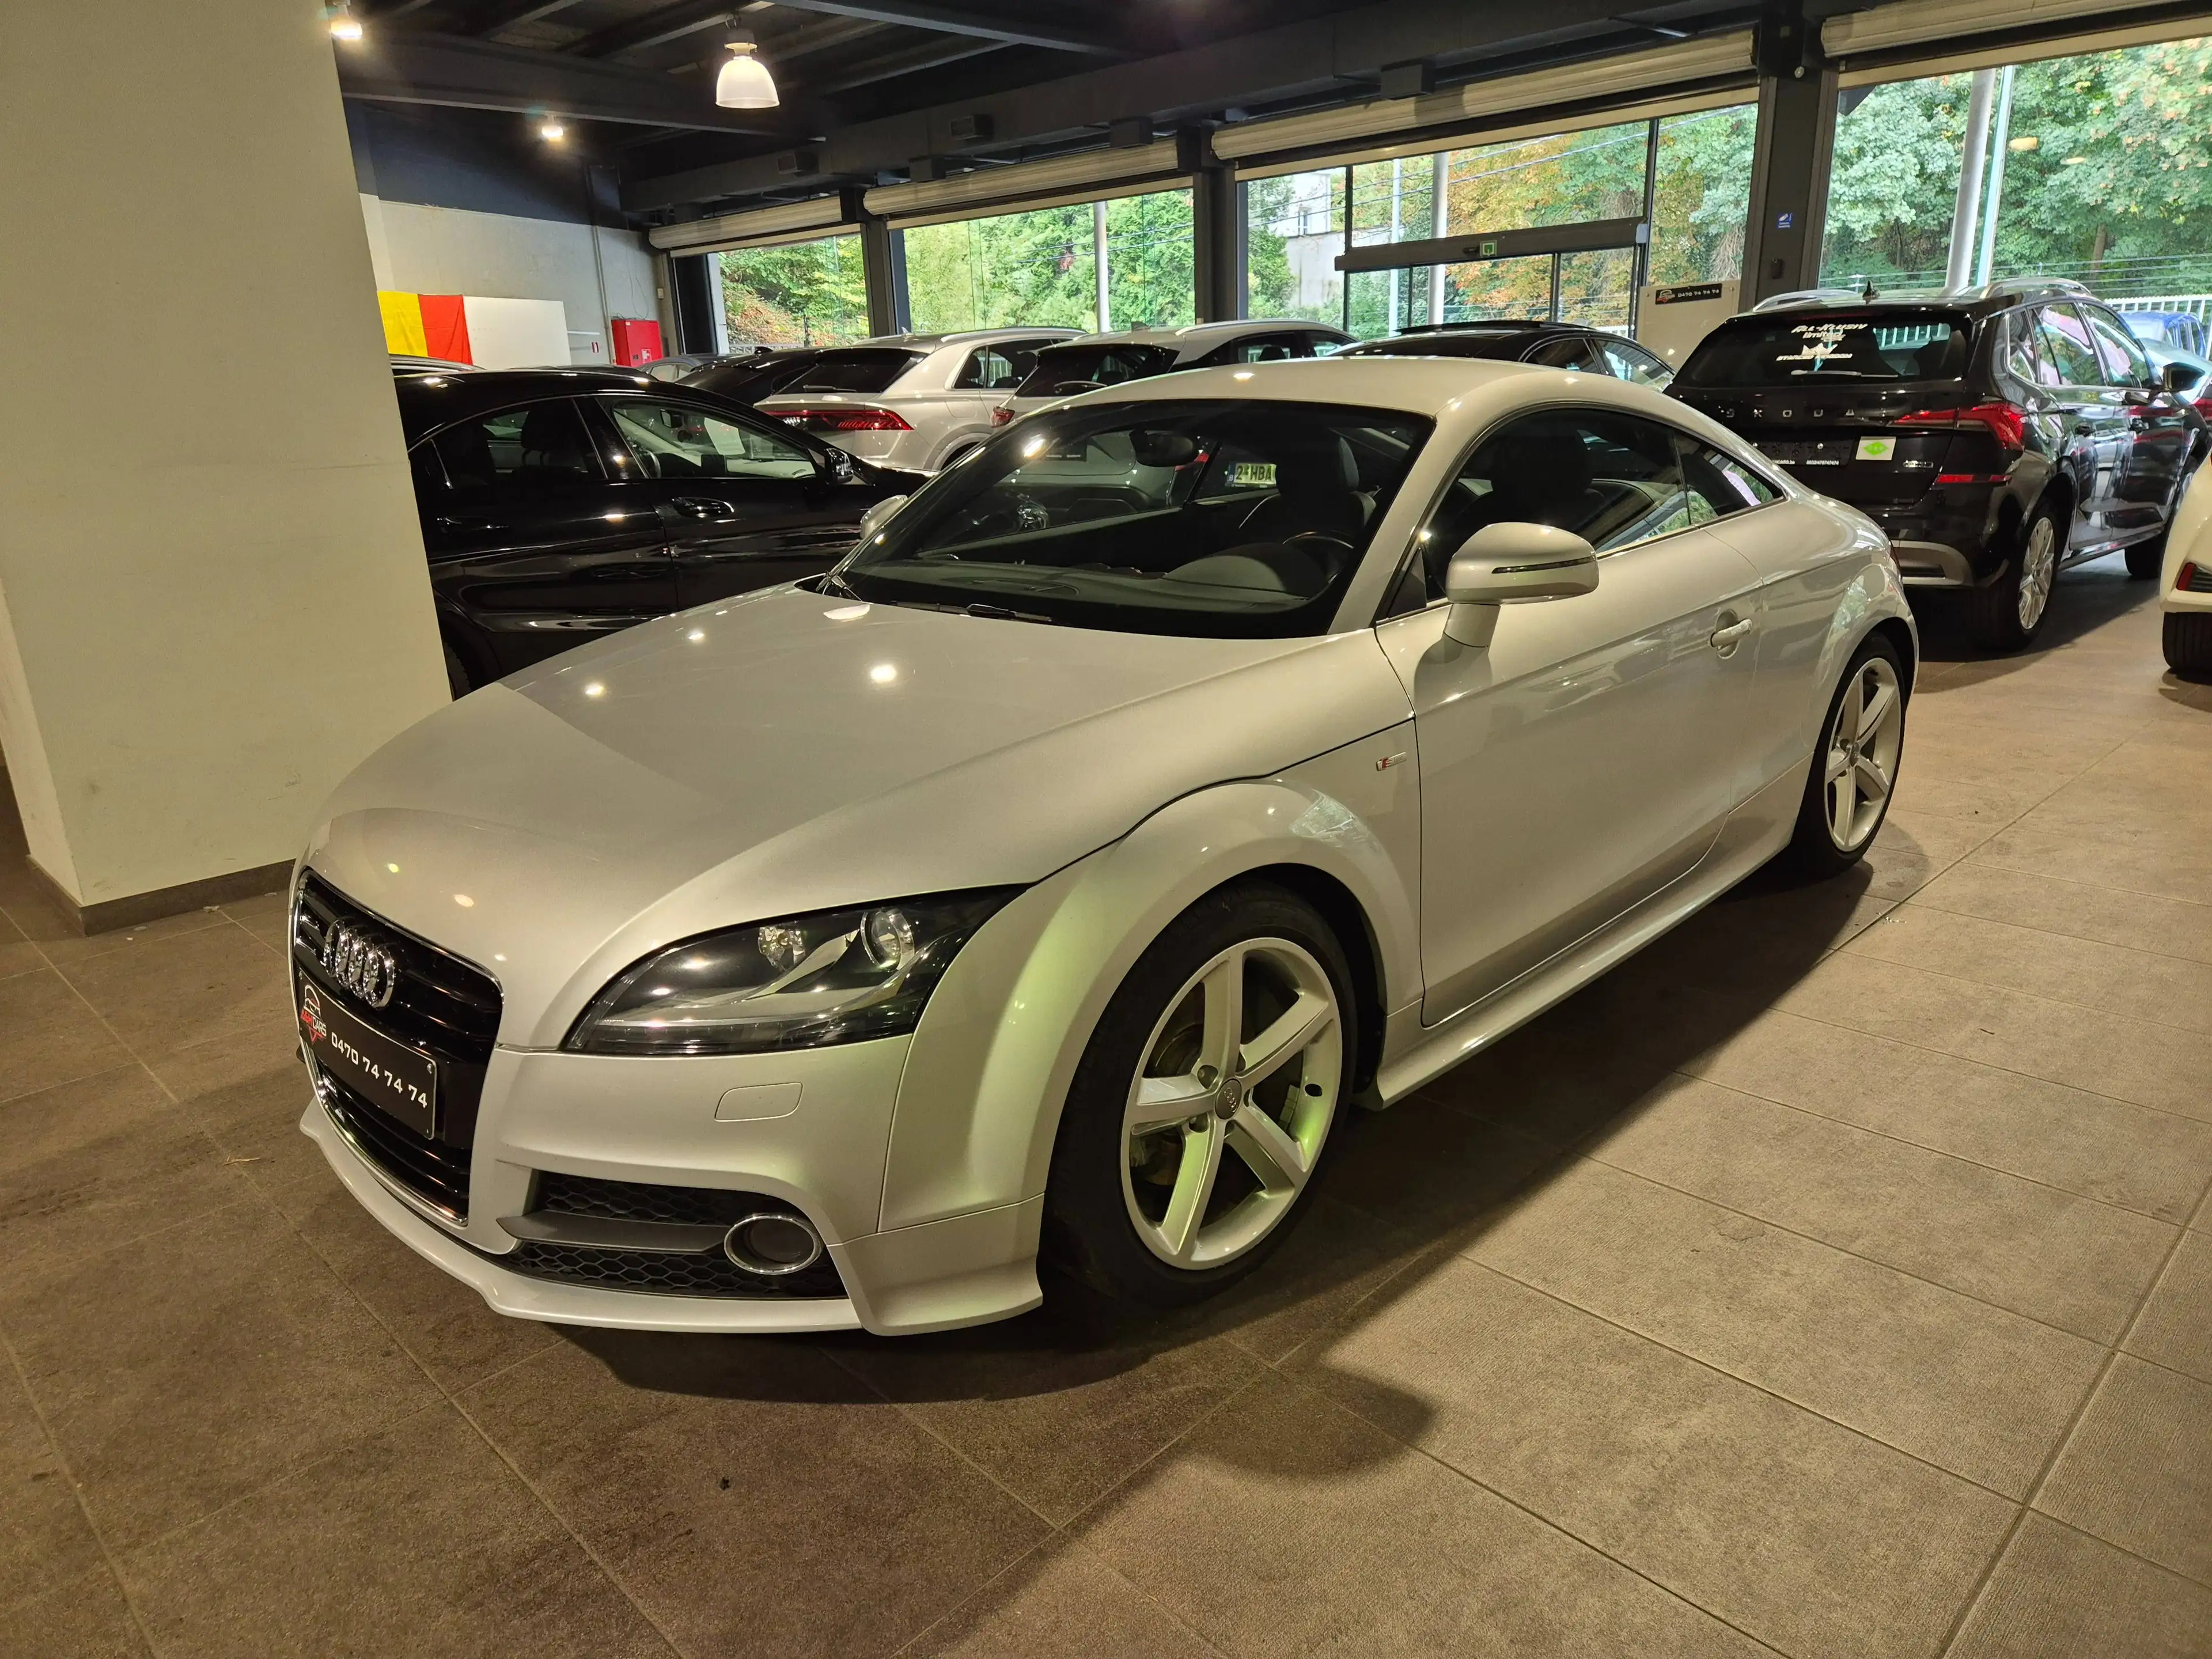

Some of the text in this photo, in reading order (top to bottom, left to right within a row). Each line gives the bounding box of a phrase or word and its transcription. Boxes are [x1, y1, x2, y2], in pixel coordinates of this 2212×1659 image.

[331, 1032, 428, 1108] 0470 74 74 74
